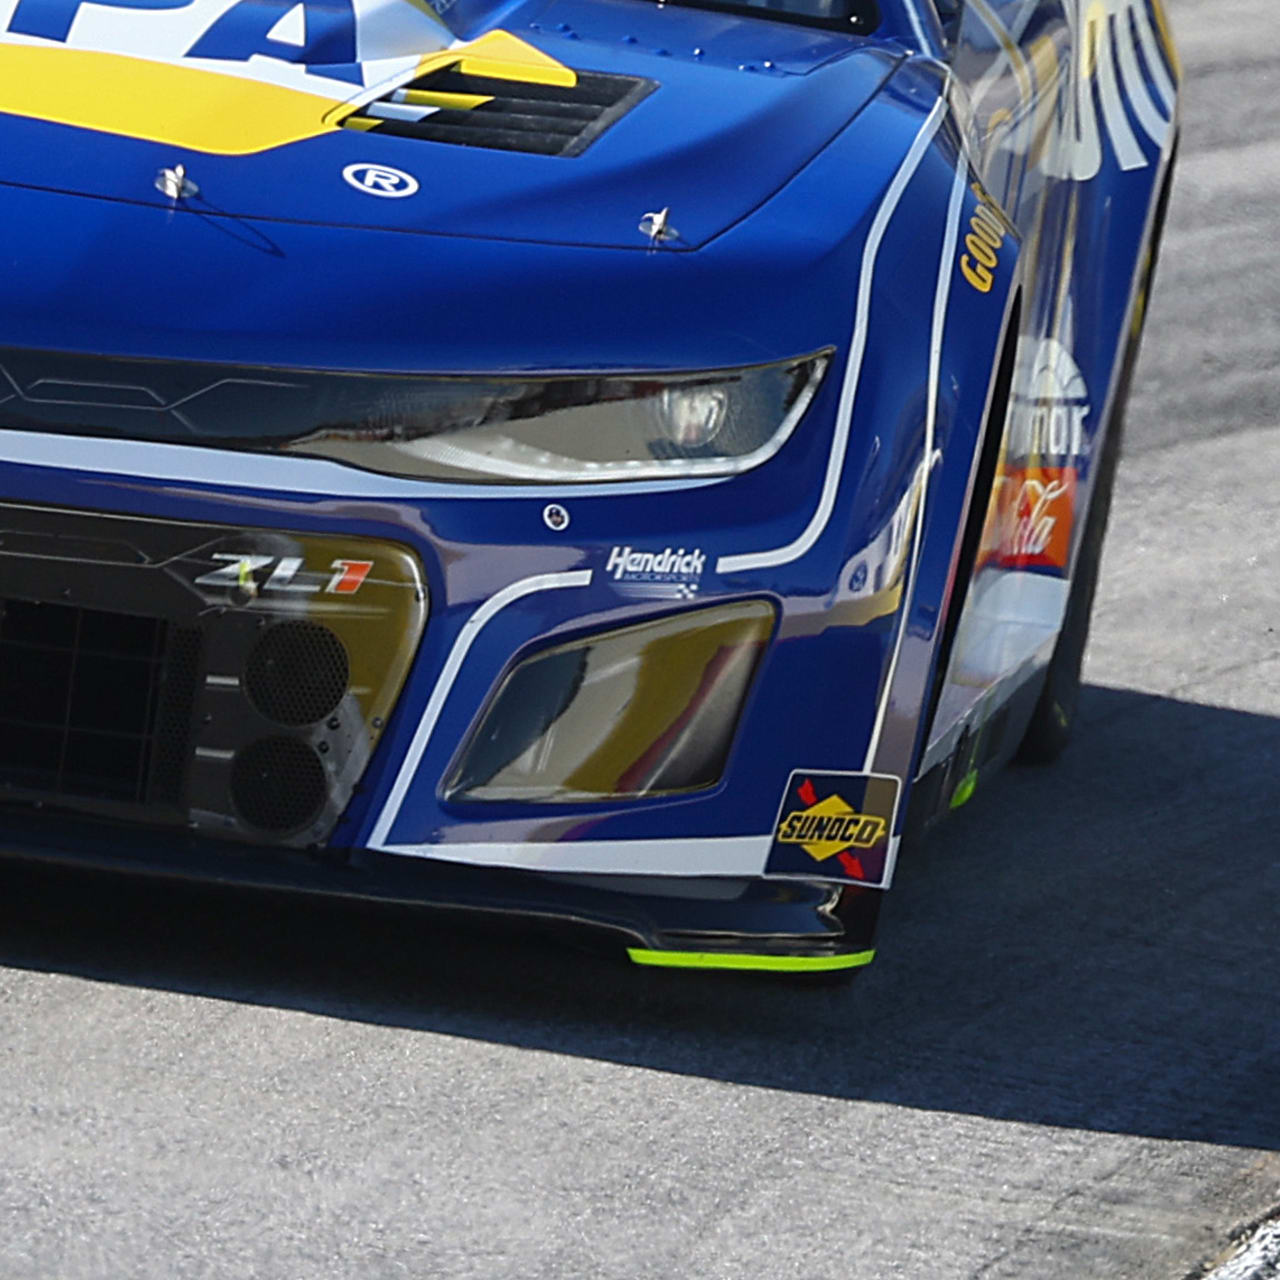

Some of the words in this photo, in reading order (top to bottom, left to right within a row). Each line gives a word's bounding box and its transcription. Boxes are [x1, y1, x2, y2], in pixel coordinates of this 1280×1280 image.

[194, 552, 374, 595] ZL1
[605, 545, 706, 580] Hendrick
[781, 814, 882, 845] SUNOCO
